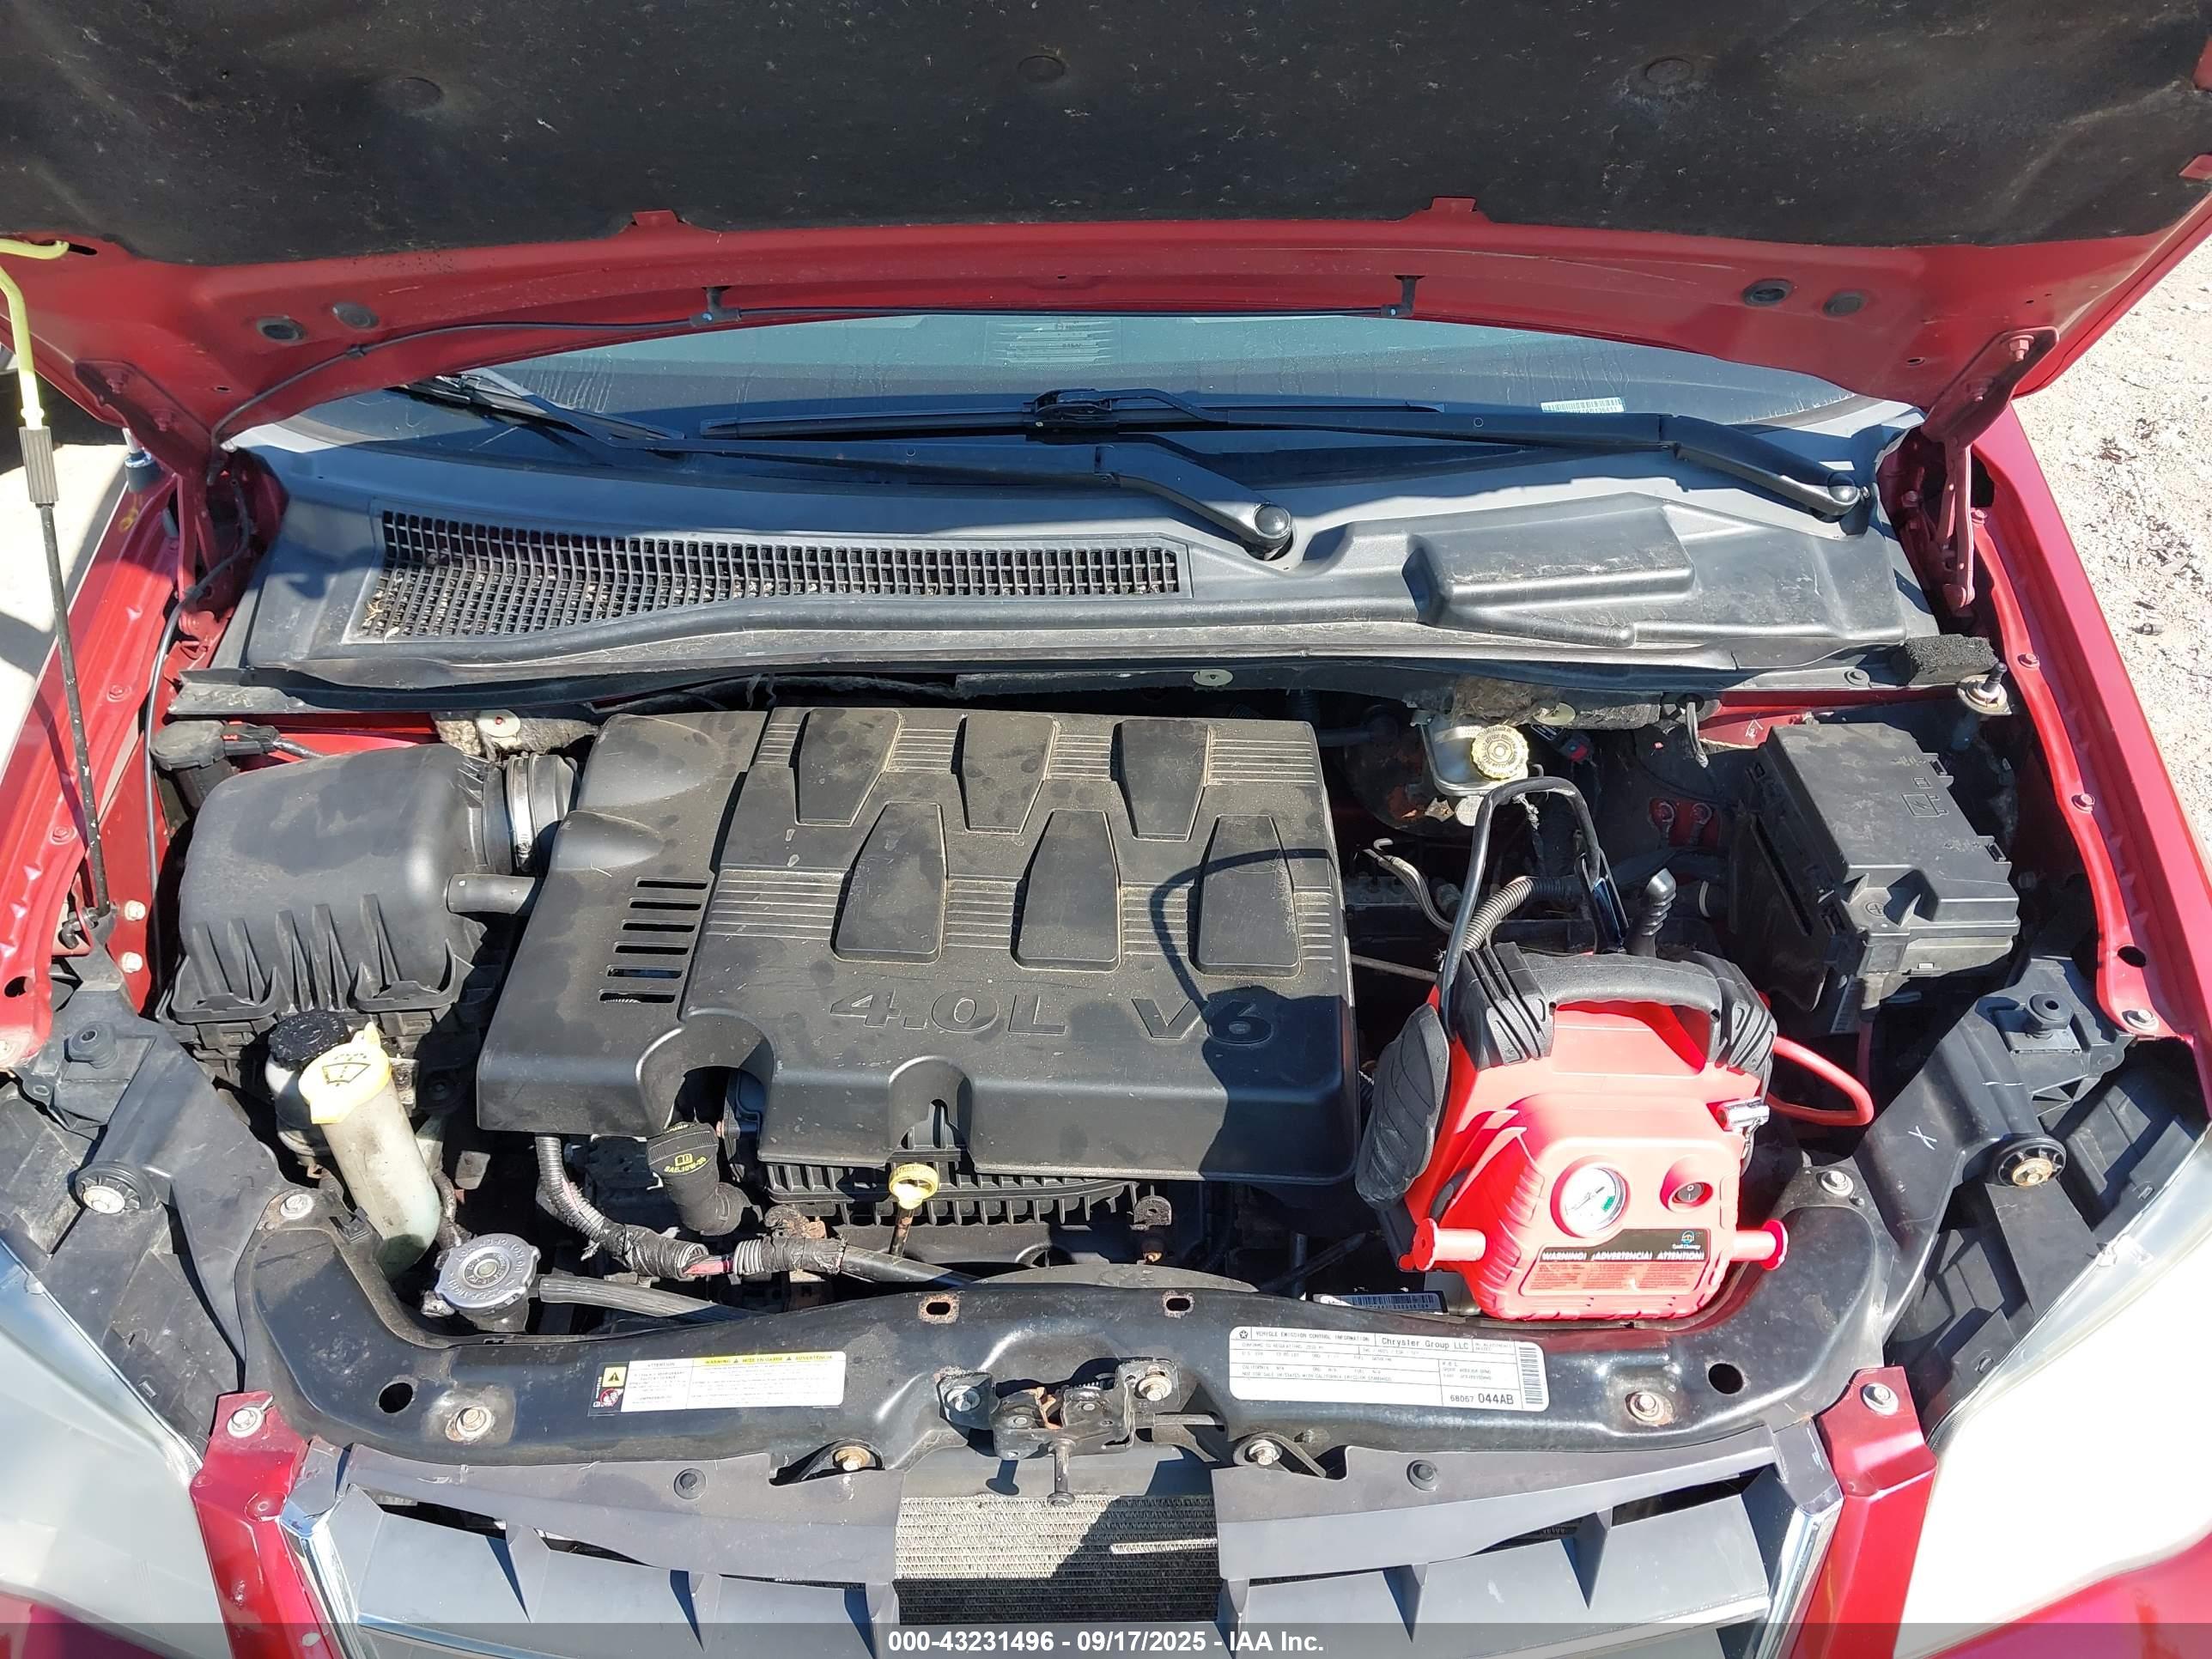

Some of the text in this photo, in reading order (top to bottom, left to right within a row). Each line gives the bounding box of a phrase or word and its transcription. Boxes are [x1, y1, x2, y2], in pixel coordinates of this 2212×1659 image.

[830, 987, 1274, 1045] 4.0L V6
[1541, 1250, 1588, 1261] WARNING!
[1656, 1250, 1705, 1261] ATTENTION!
[1382, 1337, 1420, 1348] Chrysler
[1425, 1340, 1450, 1351] Group
[1478, 1393, 1514, 1405] 044AB
